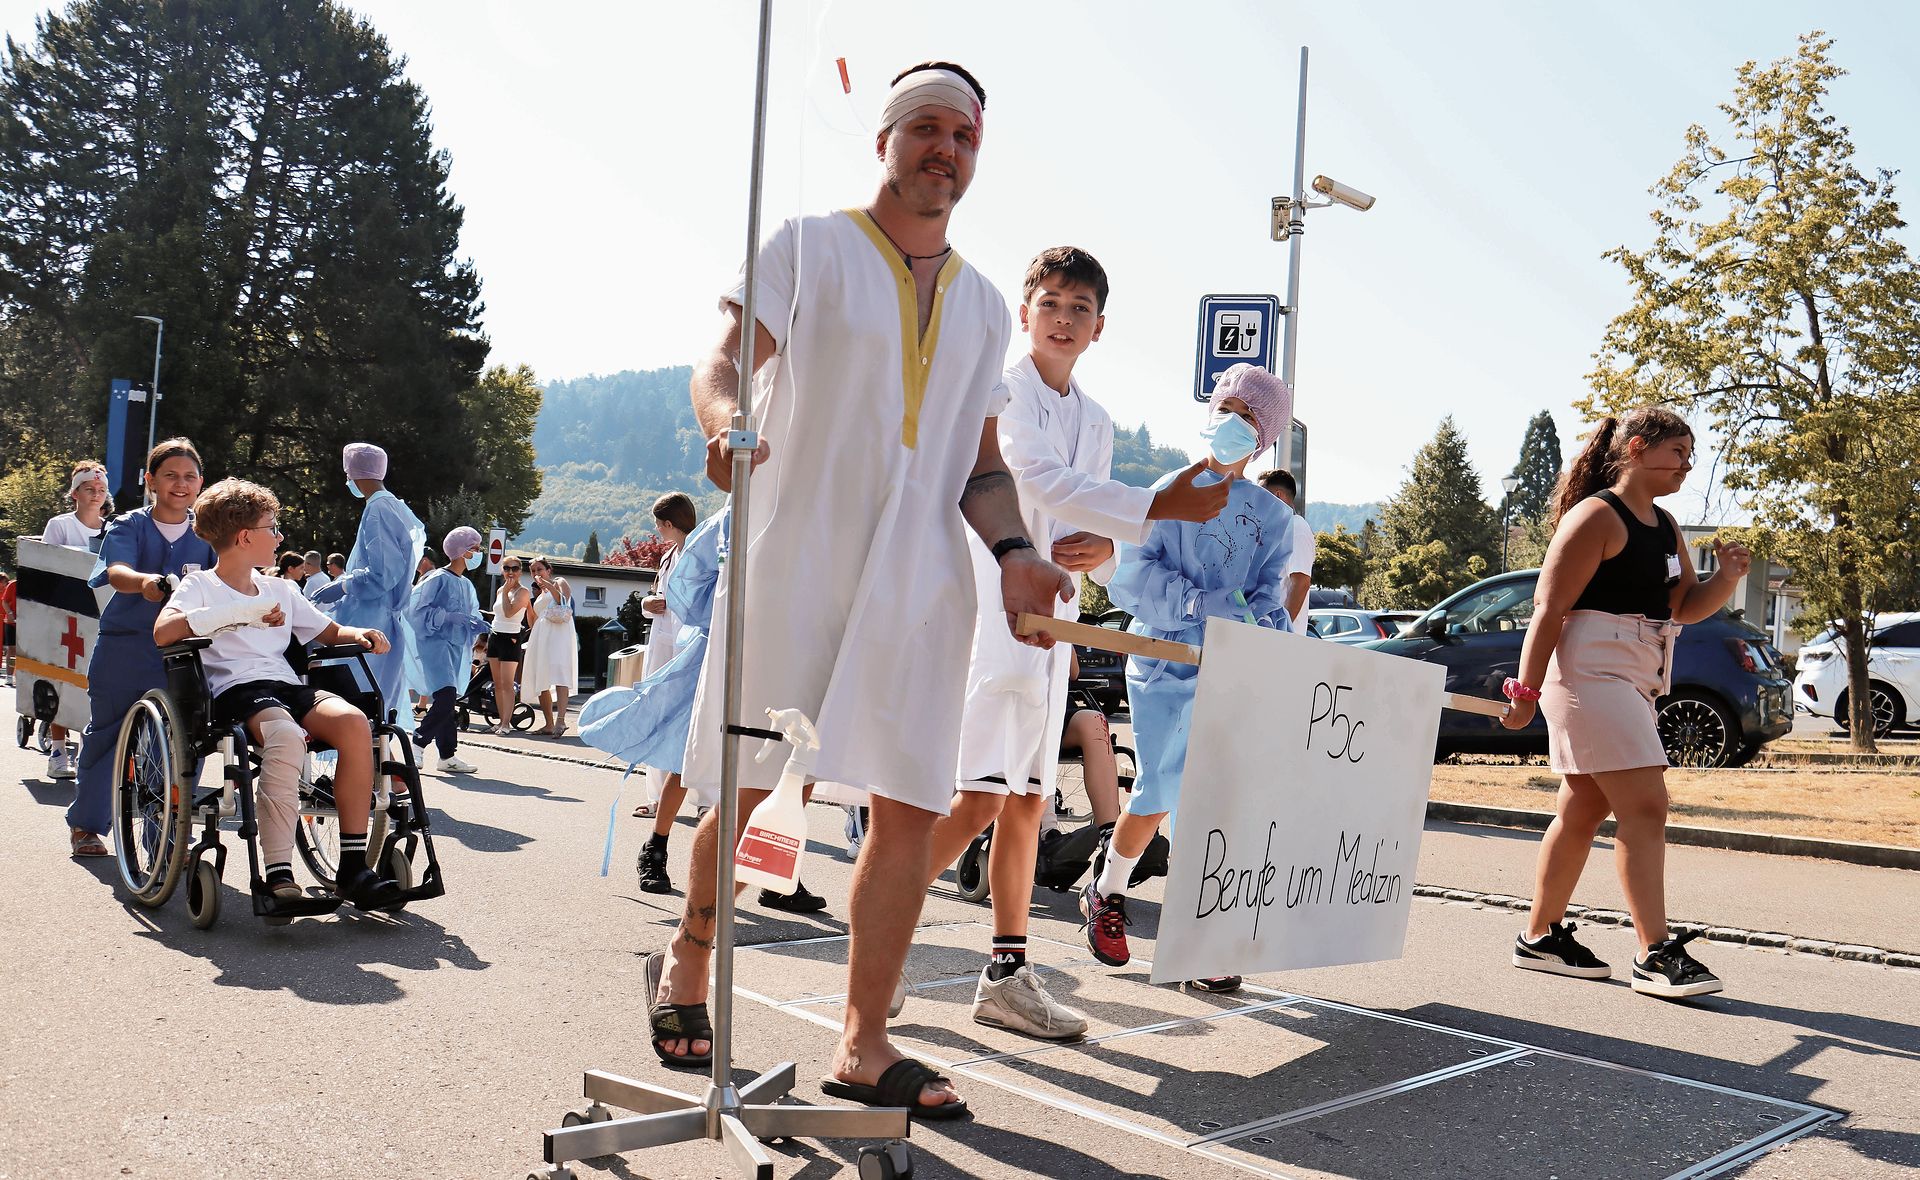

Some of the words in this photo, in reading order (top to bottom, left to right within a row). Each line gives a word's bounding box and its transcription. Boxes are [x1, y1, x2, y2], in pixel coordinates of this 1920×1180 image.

[758, 830, 799, 848] BIRCHMEIER
[1195, 820, 1277, 941] Berufe
[1286, 865, 1323, 909] um
[1328, 830, 1401, 905] Medizin
